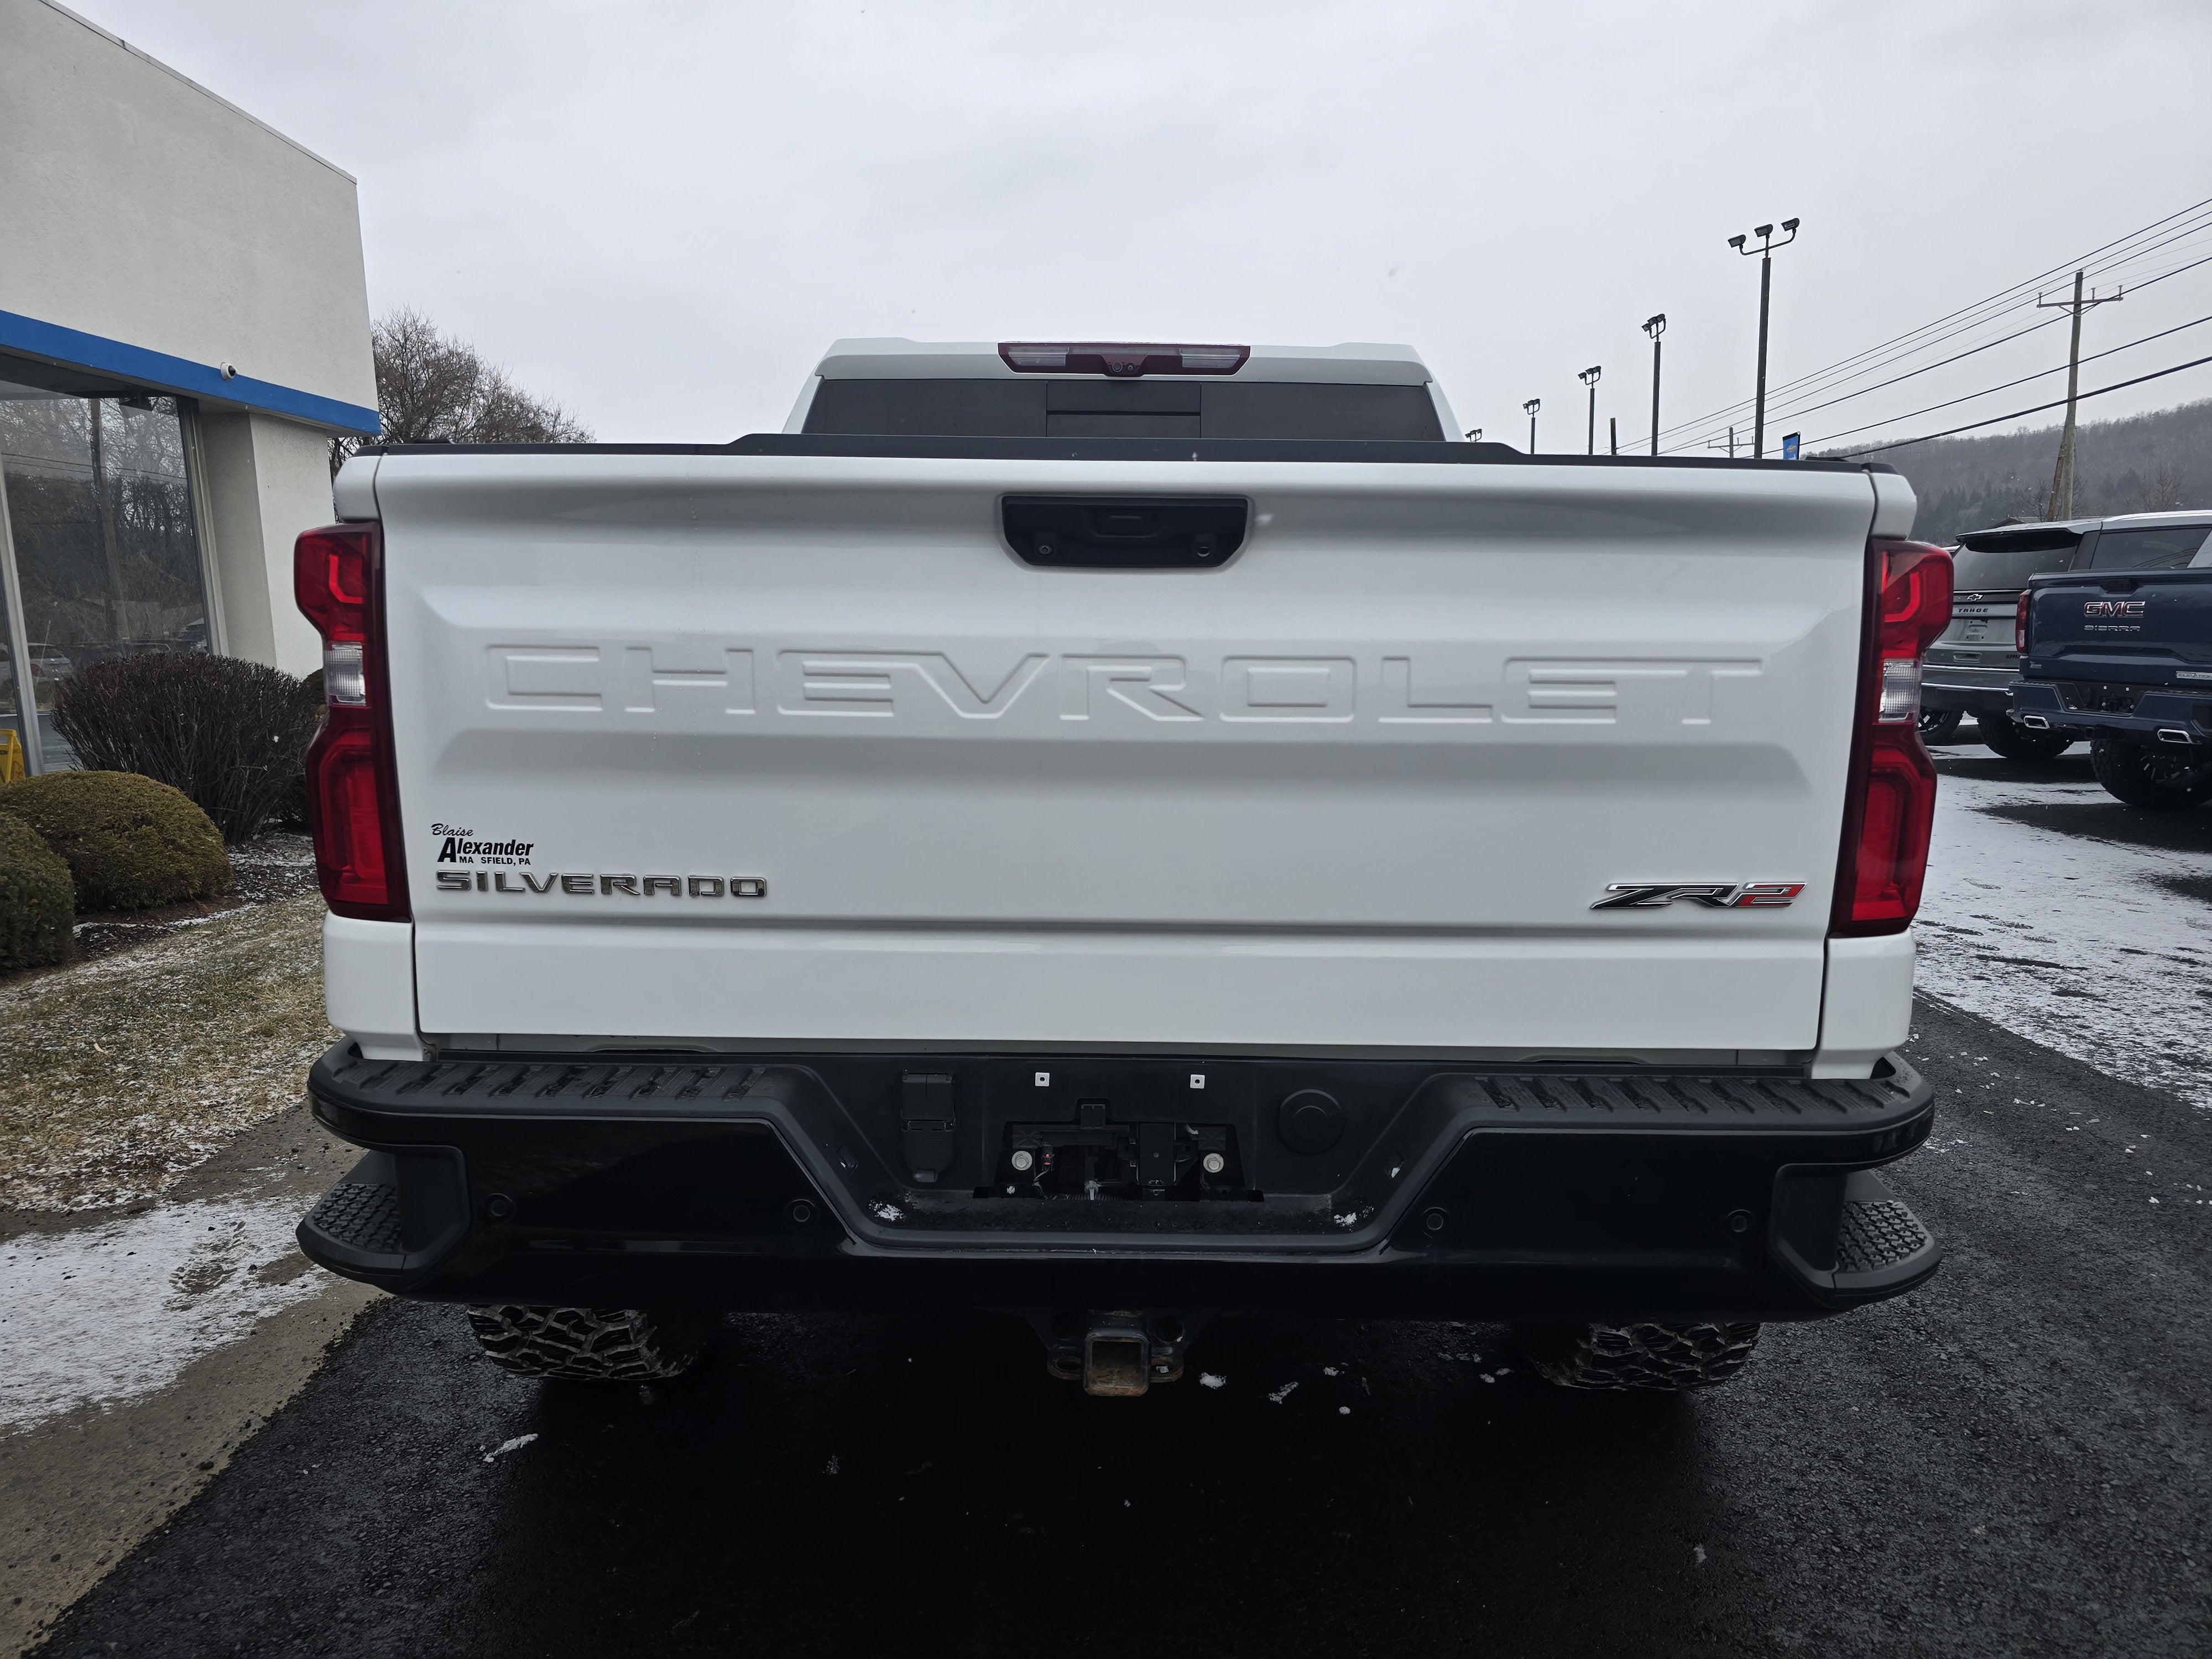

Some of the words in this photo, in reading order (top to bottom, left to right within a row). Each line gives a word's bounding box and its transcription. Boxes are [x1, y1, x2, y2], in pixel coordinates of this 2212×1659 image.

[2084, 601, 2146, 618] GMC
[485, 645, 1764, 724] CHEVROLET
[431, 823, 474, 837] Blaise
[437, 837, 534, 863] Alexander
[436, 870, 768, 898] SILVERADO
[1589, 882, 1808, 909] ZR2
